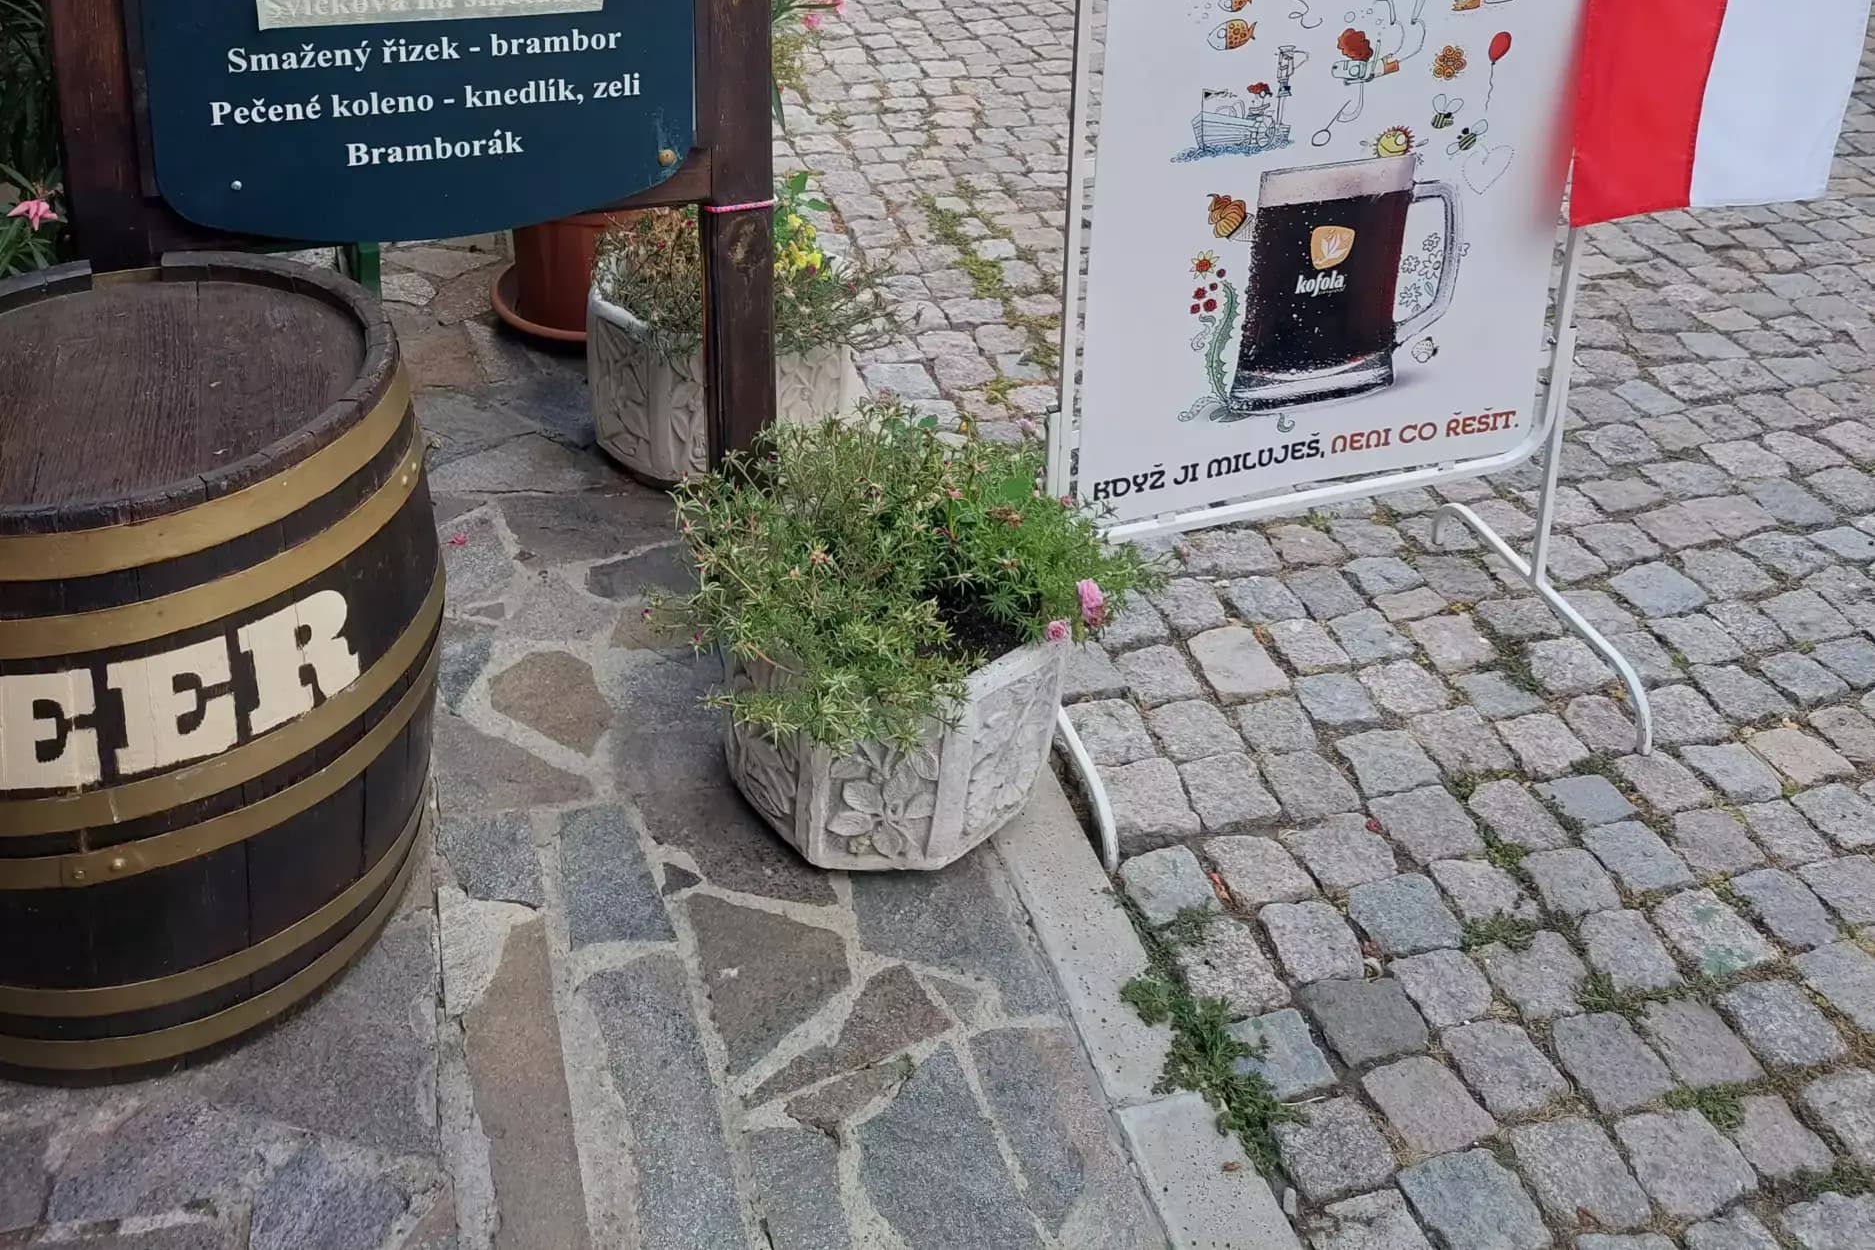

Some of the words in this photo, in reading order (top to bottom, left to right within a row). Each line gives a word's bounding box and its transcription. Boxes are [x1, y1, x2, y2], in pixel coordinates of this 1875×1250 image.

[228, 39, 371, 73] Smažený
[382, 36, 460, 65] řizek
[490, 29, 622, 57] brambor
[210, 95, 321, 126] Pečené
[332, 91, 434, 118] koleno
[464, 78, 585, 108] knedlík,
[593, 73, 641, 99] zeli
[346, 129, 524, 167] Bramborák
[1294, 270, 1345, 297] kofola
[1092, 463, 1166, 501] KDYŽ
[1173, 463, 1199, 486] JI
[1206, 432, 1325, 479] MILUJEŠ,
[1398, 421, 1438, 444] CO
[1445, 406, 1519, 438] ŘEŠIT.
